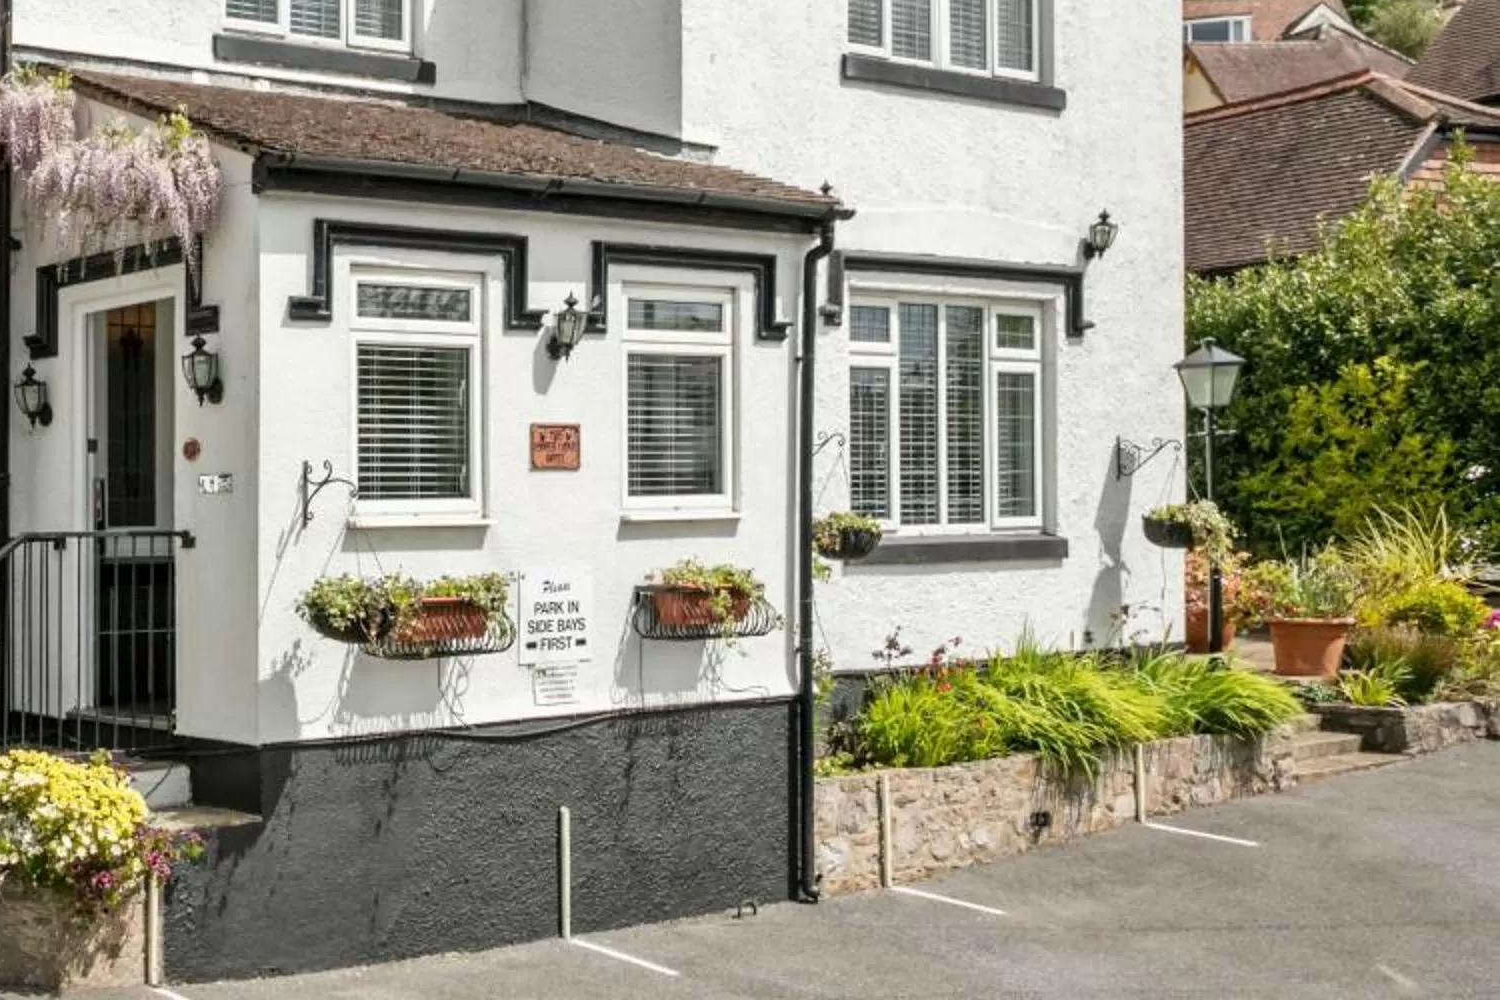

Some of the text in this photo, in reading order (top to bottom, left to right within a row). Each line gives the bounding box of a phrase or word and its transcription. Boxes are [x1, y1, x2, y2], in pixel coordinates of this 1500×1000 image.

[533, 600, 580, 615] PARK IN
[527, 617, 587, 634] SIDE BAYS
[540, 635, 573, 650] FIRST
